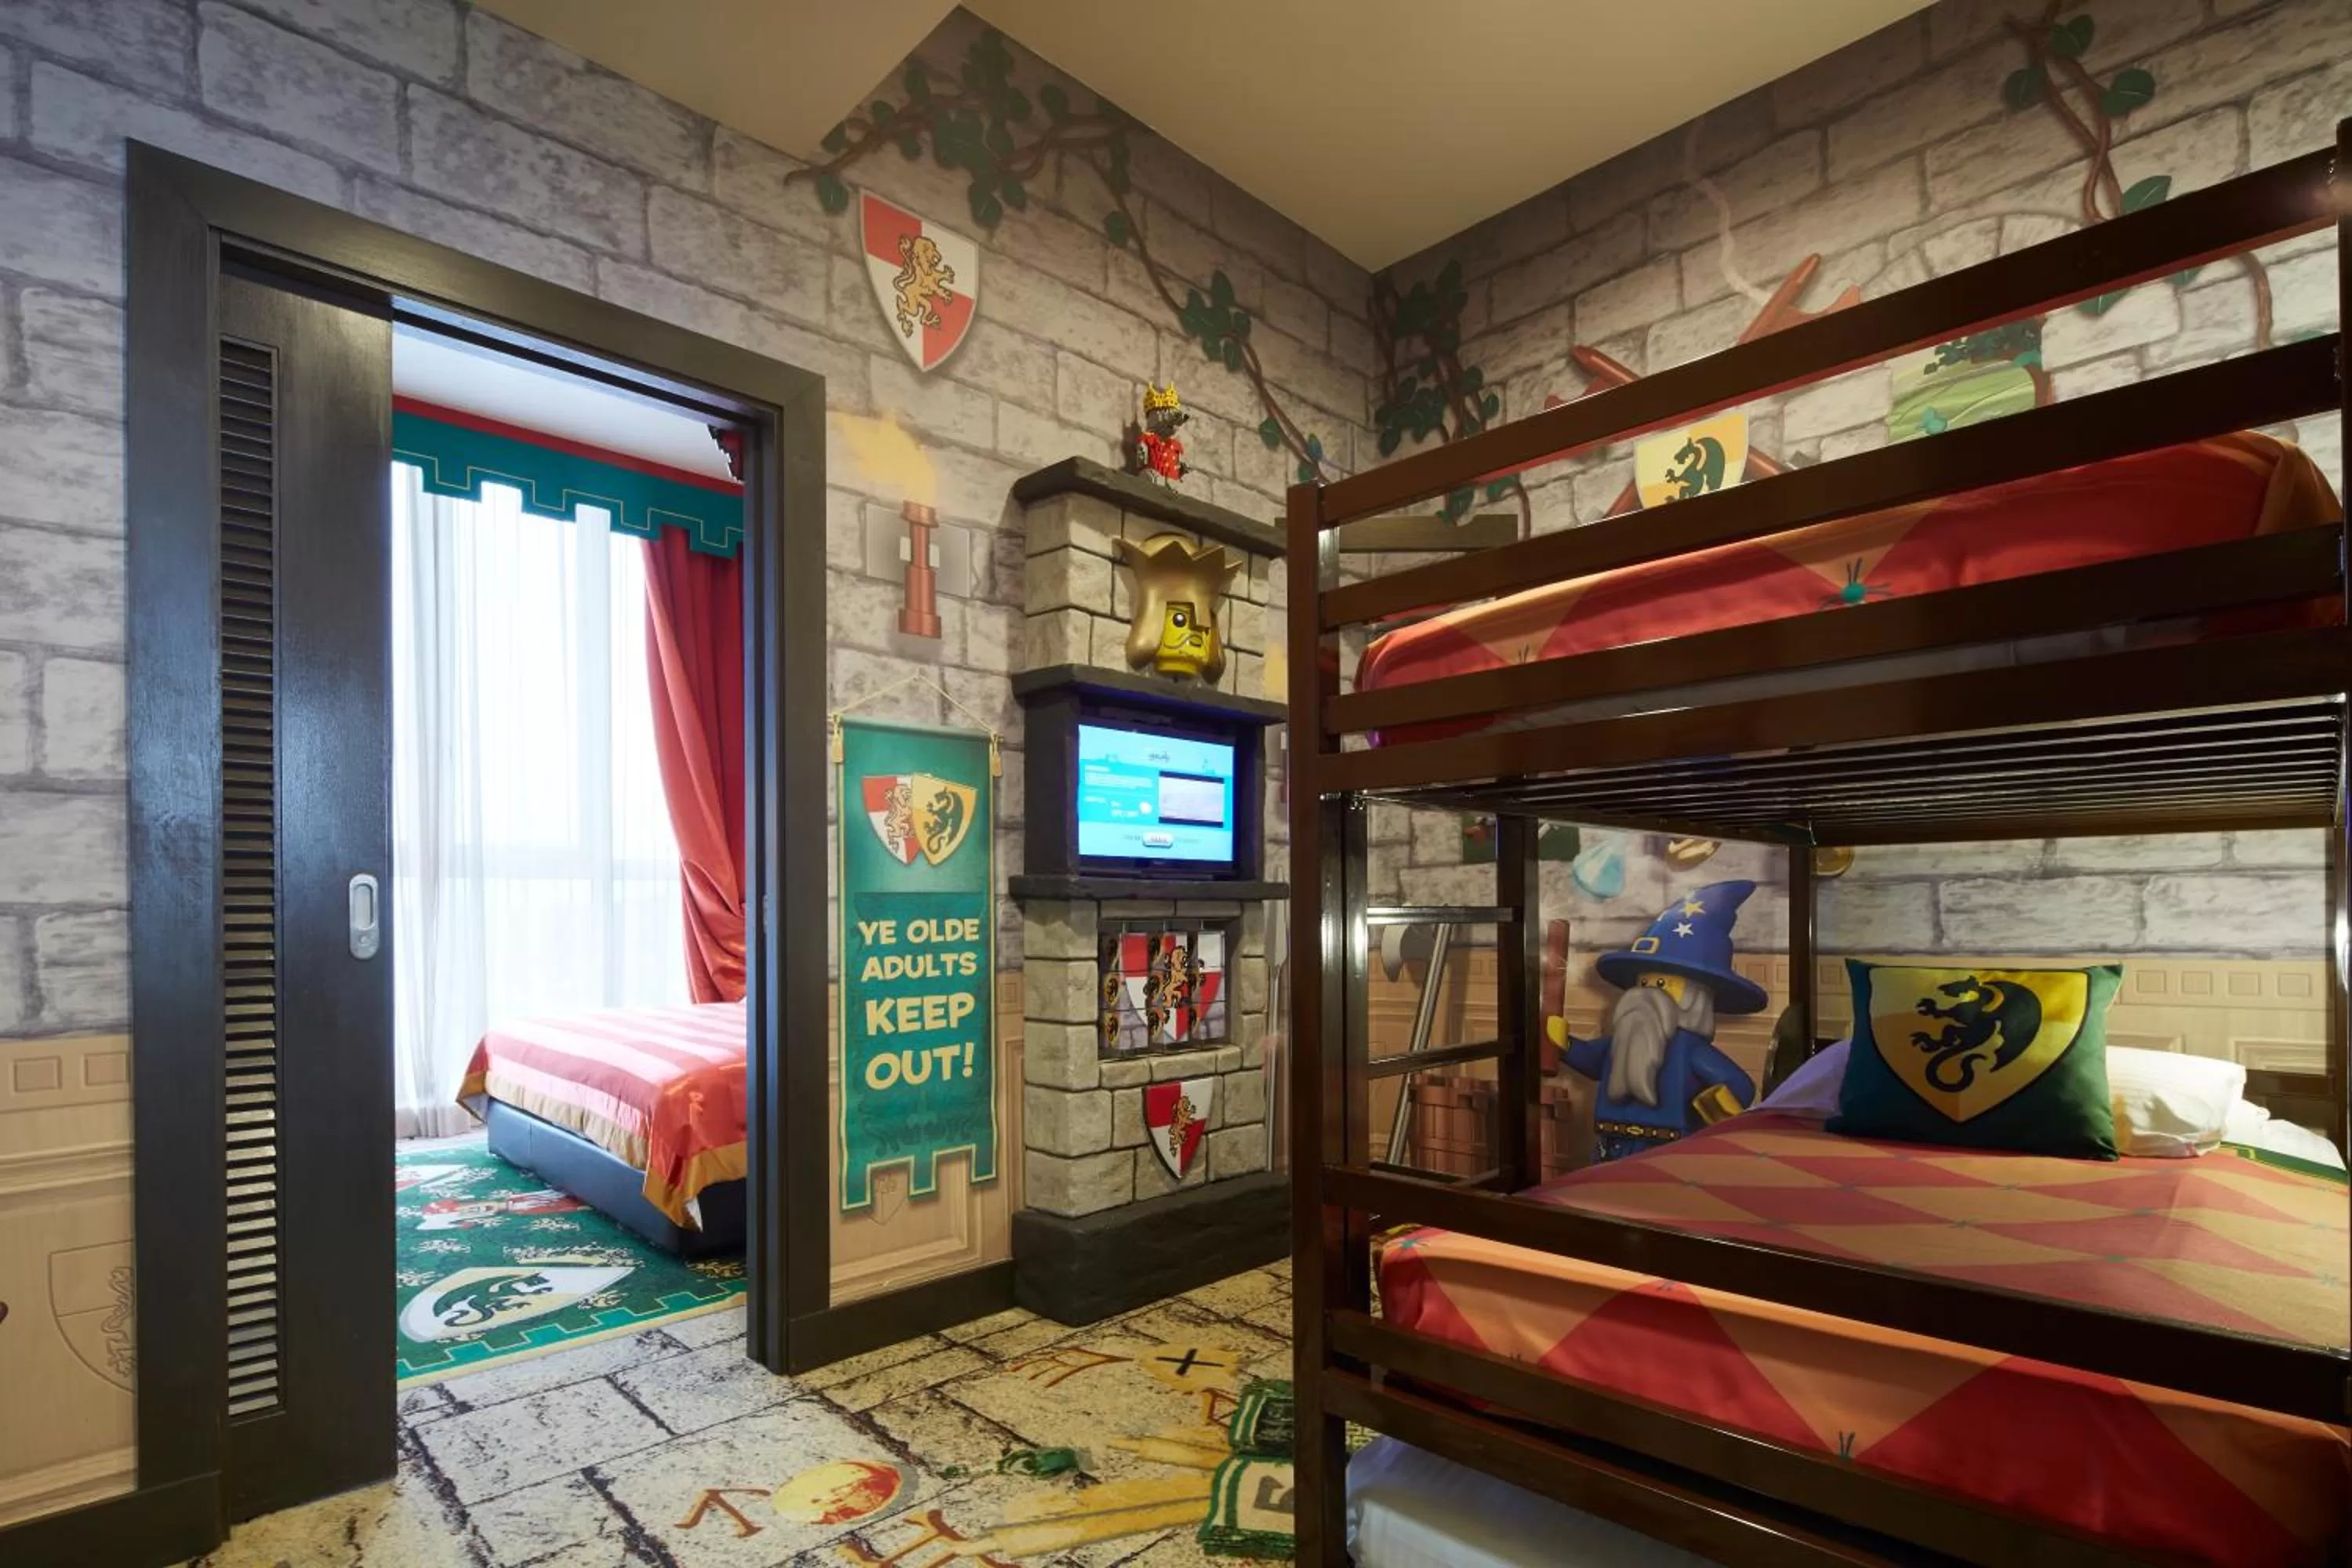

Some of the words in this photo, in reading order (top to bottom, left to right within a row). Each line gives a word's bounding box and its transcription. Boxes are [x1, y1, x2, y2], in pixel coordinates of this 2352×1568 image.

[858, 920, 897, 946] YE
[906, 919, 979, 944] OLDE
[862, 953, 978, 982] ADULTS
[866, 993, 975, 1035] KEEP
[866, 1043, 975, 1090] OUT!
